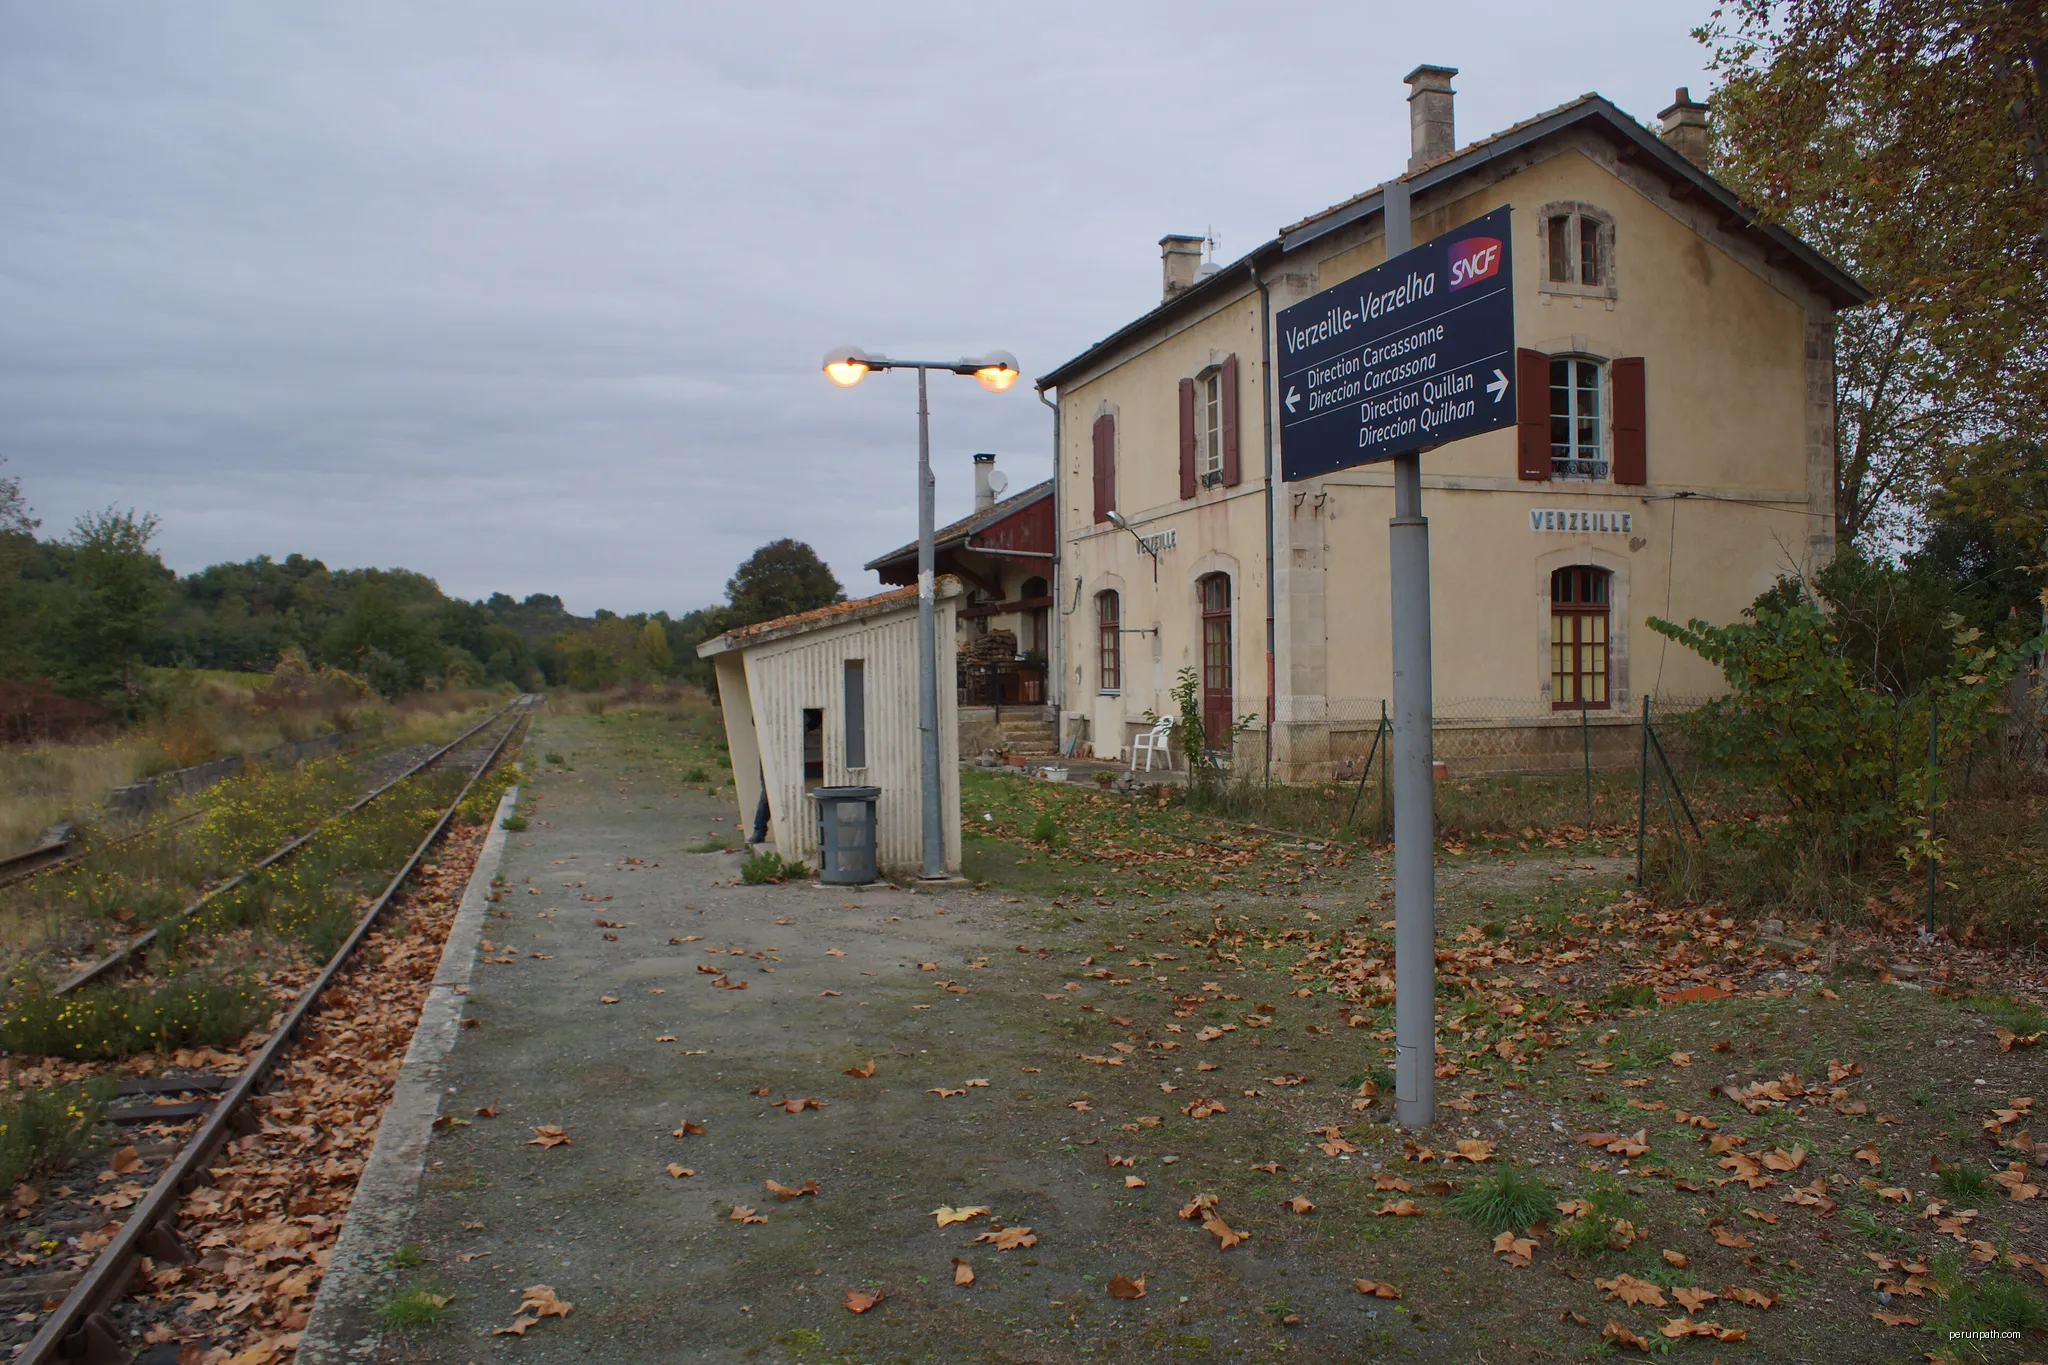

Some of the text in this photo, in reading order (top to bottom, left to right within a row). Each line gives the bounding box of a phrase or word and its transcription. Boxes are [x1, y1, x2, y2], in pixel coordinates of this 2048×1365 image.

[1450, 245, 1498, 286] SNCF
[1285, 271, 1435, 354] Verzeille-Verzelha
[1307, 324, 1444, 389] Direction Carcassonne
[1308, 352, 1437, 412] Direccion Carcassona
[1359, 398, 1475, 448] Direccion Quilhan
[1361, 372, 1474, 423] Direction Quillan
[1531, 511, 1631, 532] VERZEILLE
